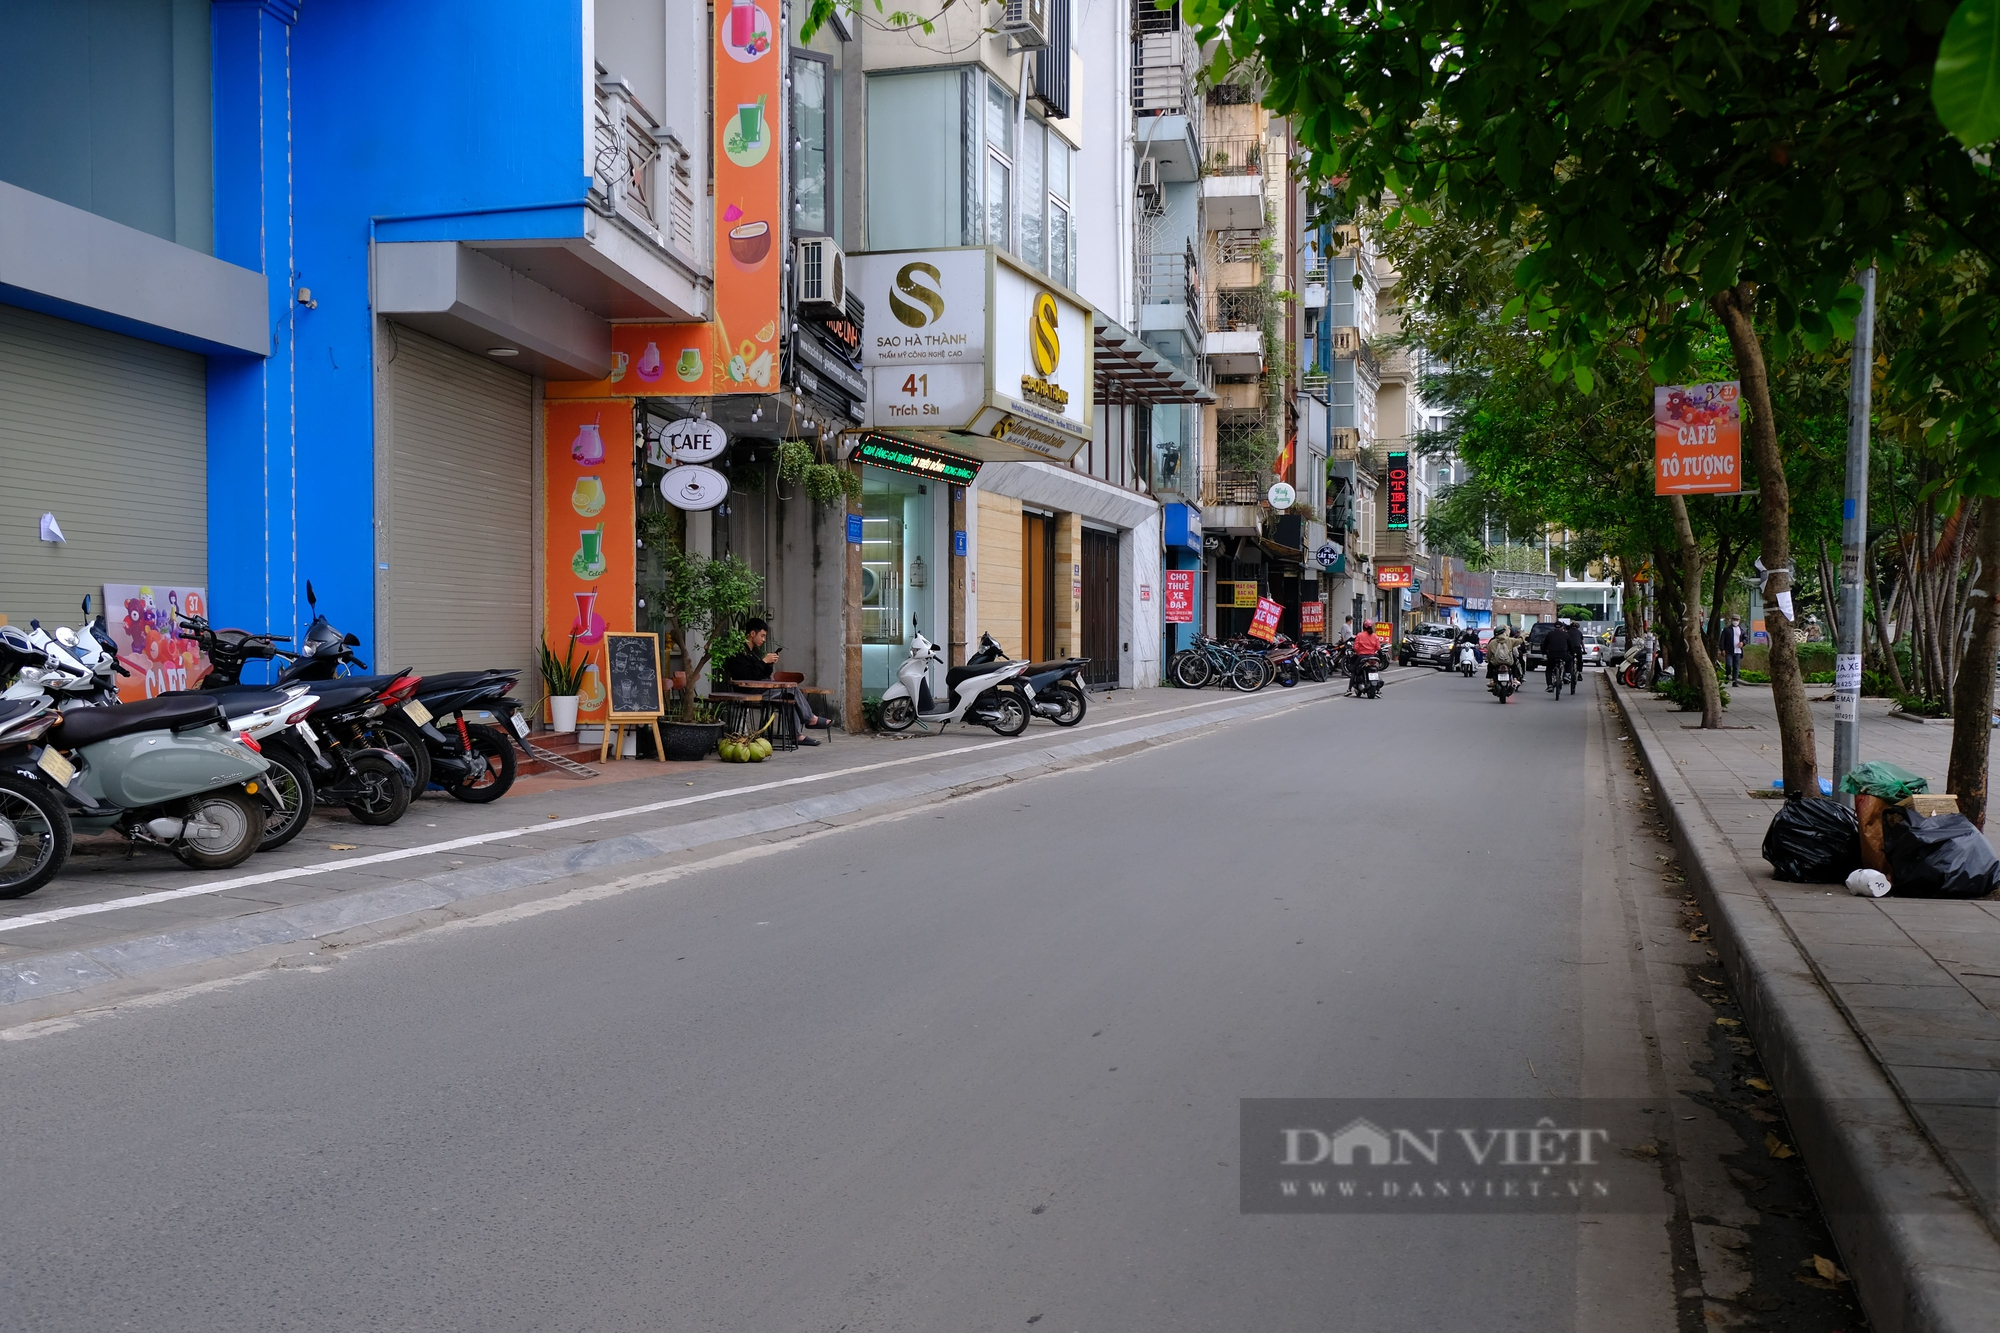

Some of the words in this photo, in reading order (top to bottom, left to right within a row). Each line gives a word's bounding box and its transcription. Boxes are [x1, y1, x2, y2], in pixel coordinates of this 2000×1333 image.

[876, 336, 901, 347] SAO
[904, 333, 923, 346] HÀ
[924, 332, 967, 346] THÀNH
[897, 350, 908, 359] MỸ
[908, 350, 927, 358] CÔNG
[928, 349, 946, 359] NGHỆ
[901, 373, 928, 397] 41
[1723, 386, 1734, 396] 37
[888, 404, 918, 416] Trích
[922, 403, 940, 415] Sài
[1677, 419, 1717, 446] CAFÉ
[671, 429, 712, 451] CAFÉ
[1661, 452, 1680, 478] TÔ
[1682, 453, 1735, 480] TƯỢNG
[1379, 573, 1400, 582] RED
[1402, 573, 1409, 582] 2
[1167, 582, 1190, 590] THUÊ
[1173, 592, 1184, 600] XE
[188, 595, 199, 612] 37
[1169, 600, 1188, 610] ĐẠP
[1255, 609, 1266, 622] XE
[1848, 663, 1859, 671] XE
